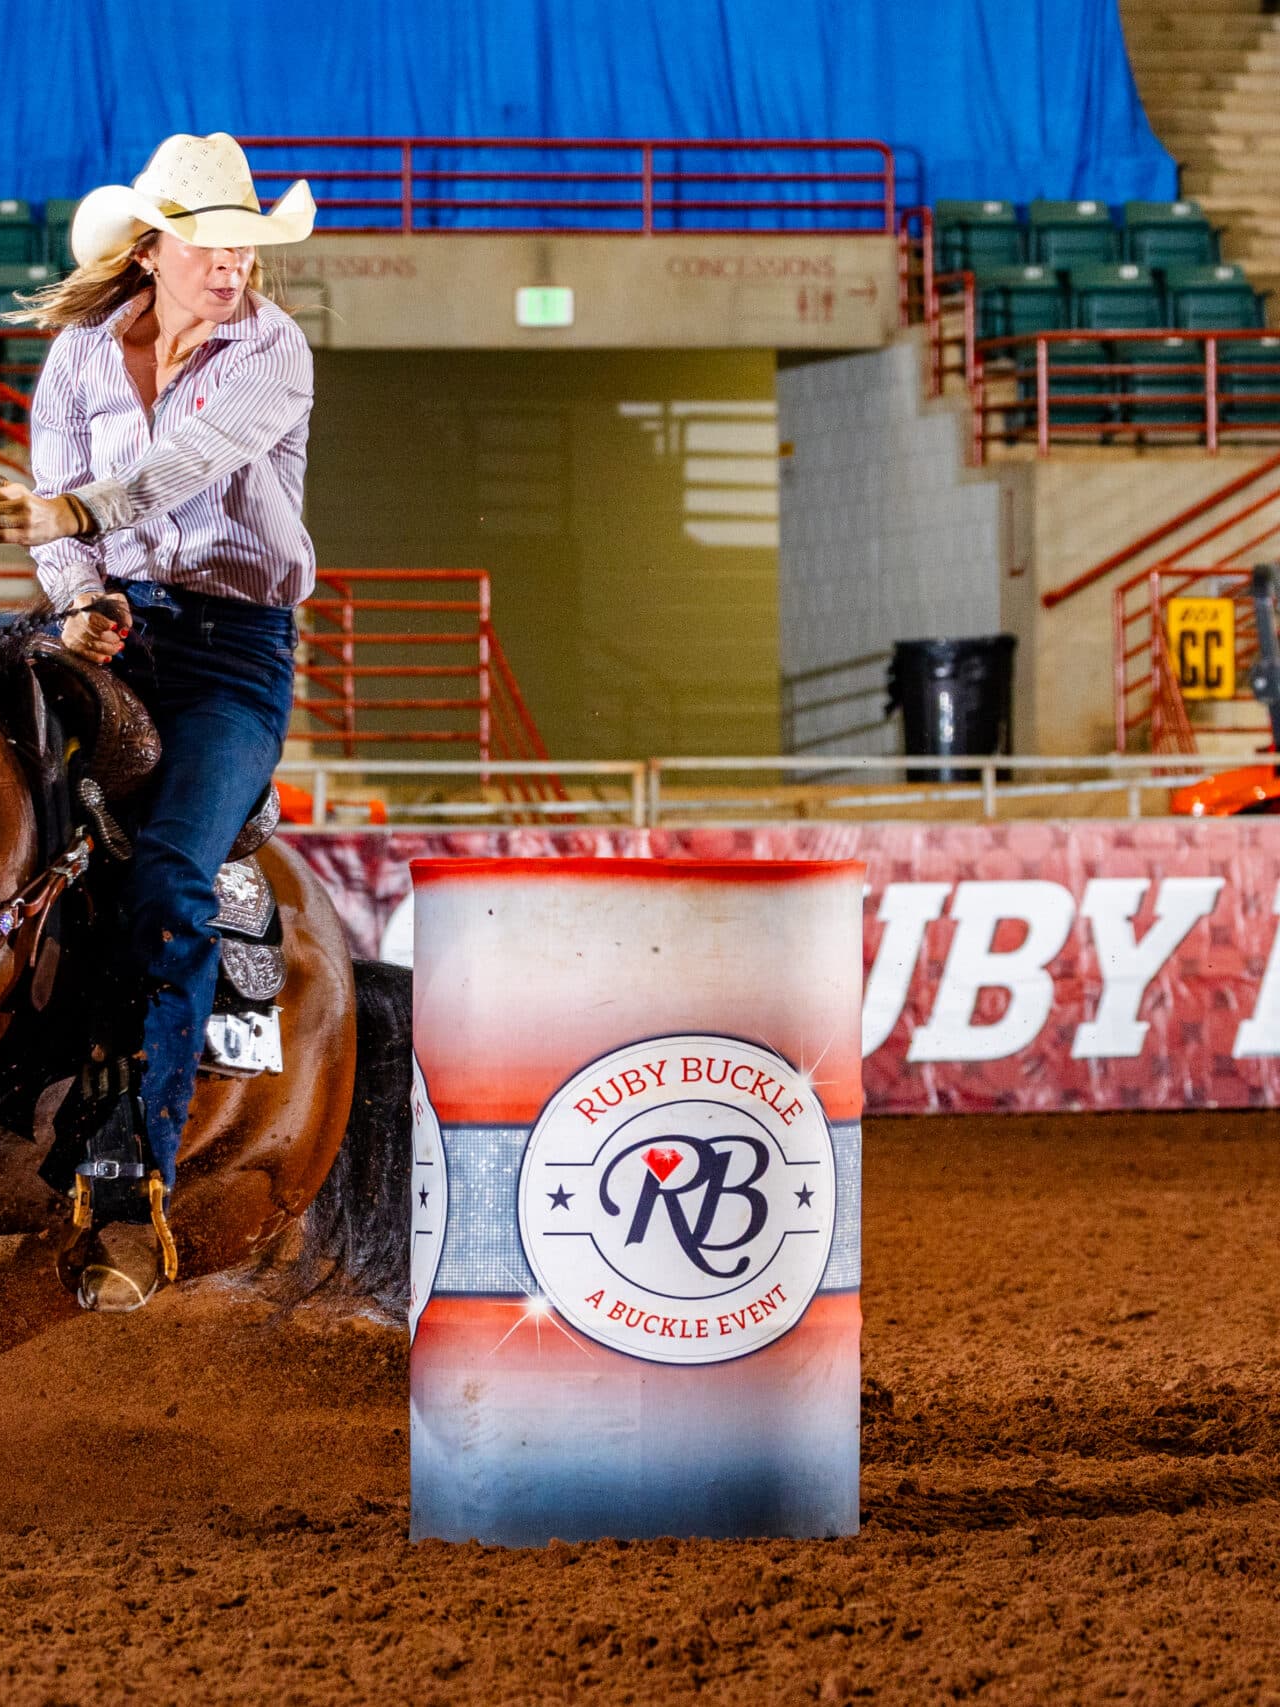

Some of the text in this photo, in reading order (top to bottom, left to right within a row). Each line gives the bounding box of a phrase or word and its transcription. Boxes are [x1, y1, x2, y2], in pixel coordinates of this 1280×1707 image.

[665, 254, 836, 277] CONCESSIONS
[863, 876, 1225, 1062] UBY
[573, 1057, 805, 1126] RUBY BUCKLE
[599, 1134, 770, 1278] RB
[584, 1283, 788, 1338] A BUCKLE EVENT
